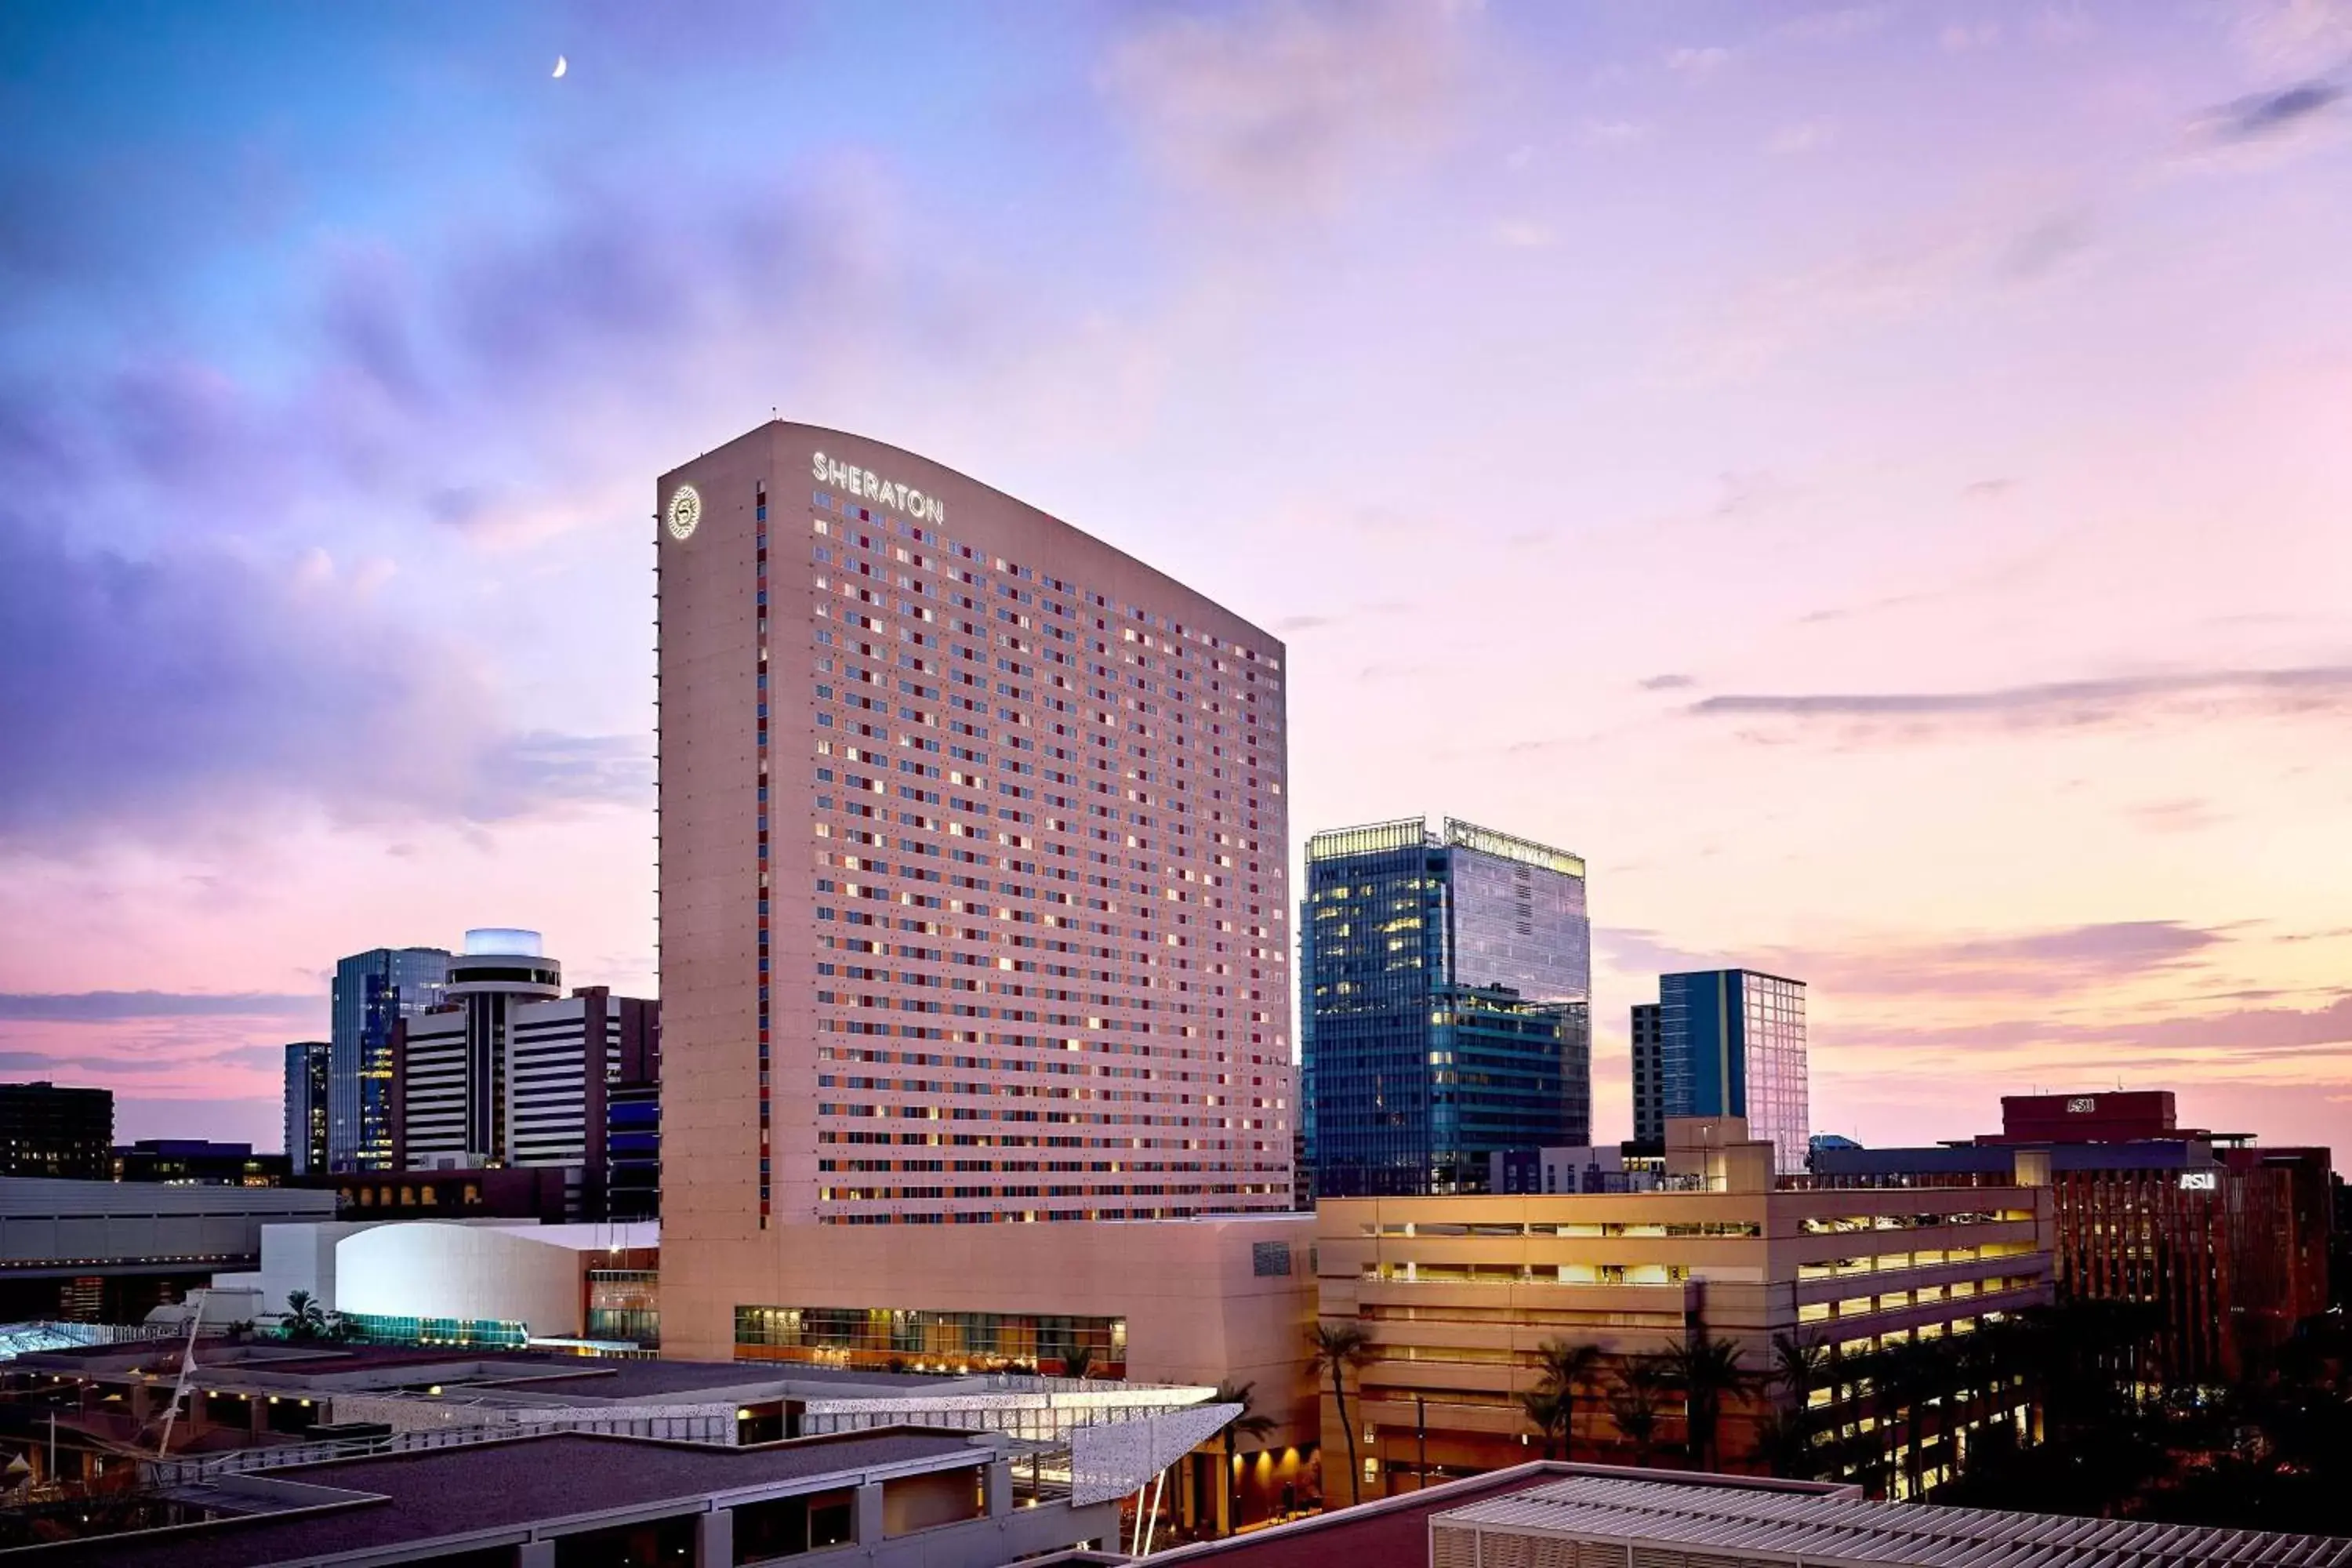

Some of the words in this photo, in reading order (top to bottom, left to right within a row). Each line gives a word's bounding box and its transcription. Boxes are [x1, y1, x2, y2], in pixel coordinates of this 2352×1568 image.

[813, 451, 944, 525] SHERATON
[2067, 1098, 2094, 1112] ASU
[2180, 1174, 2215, 1189] ASU
